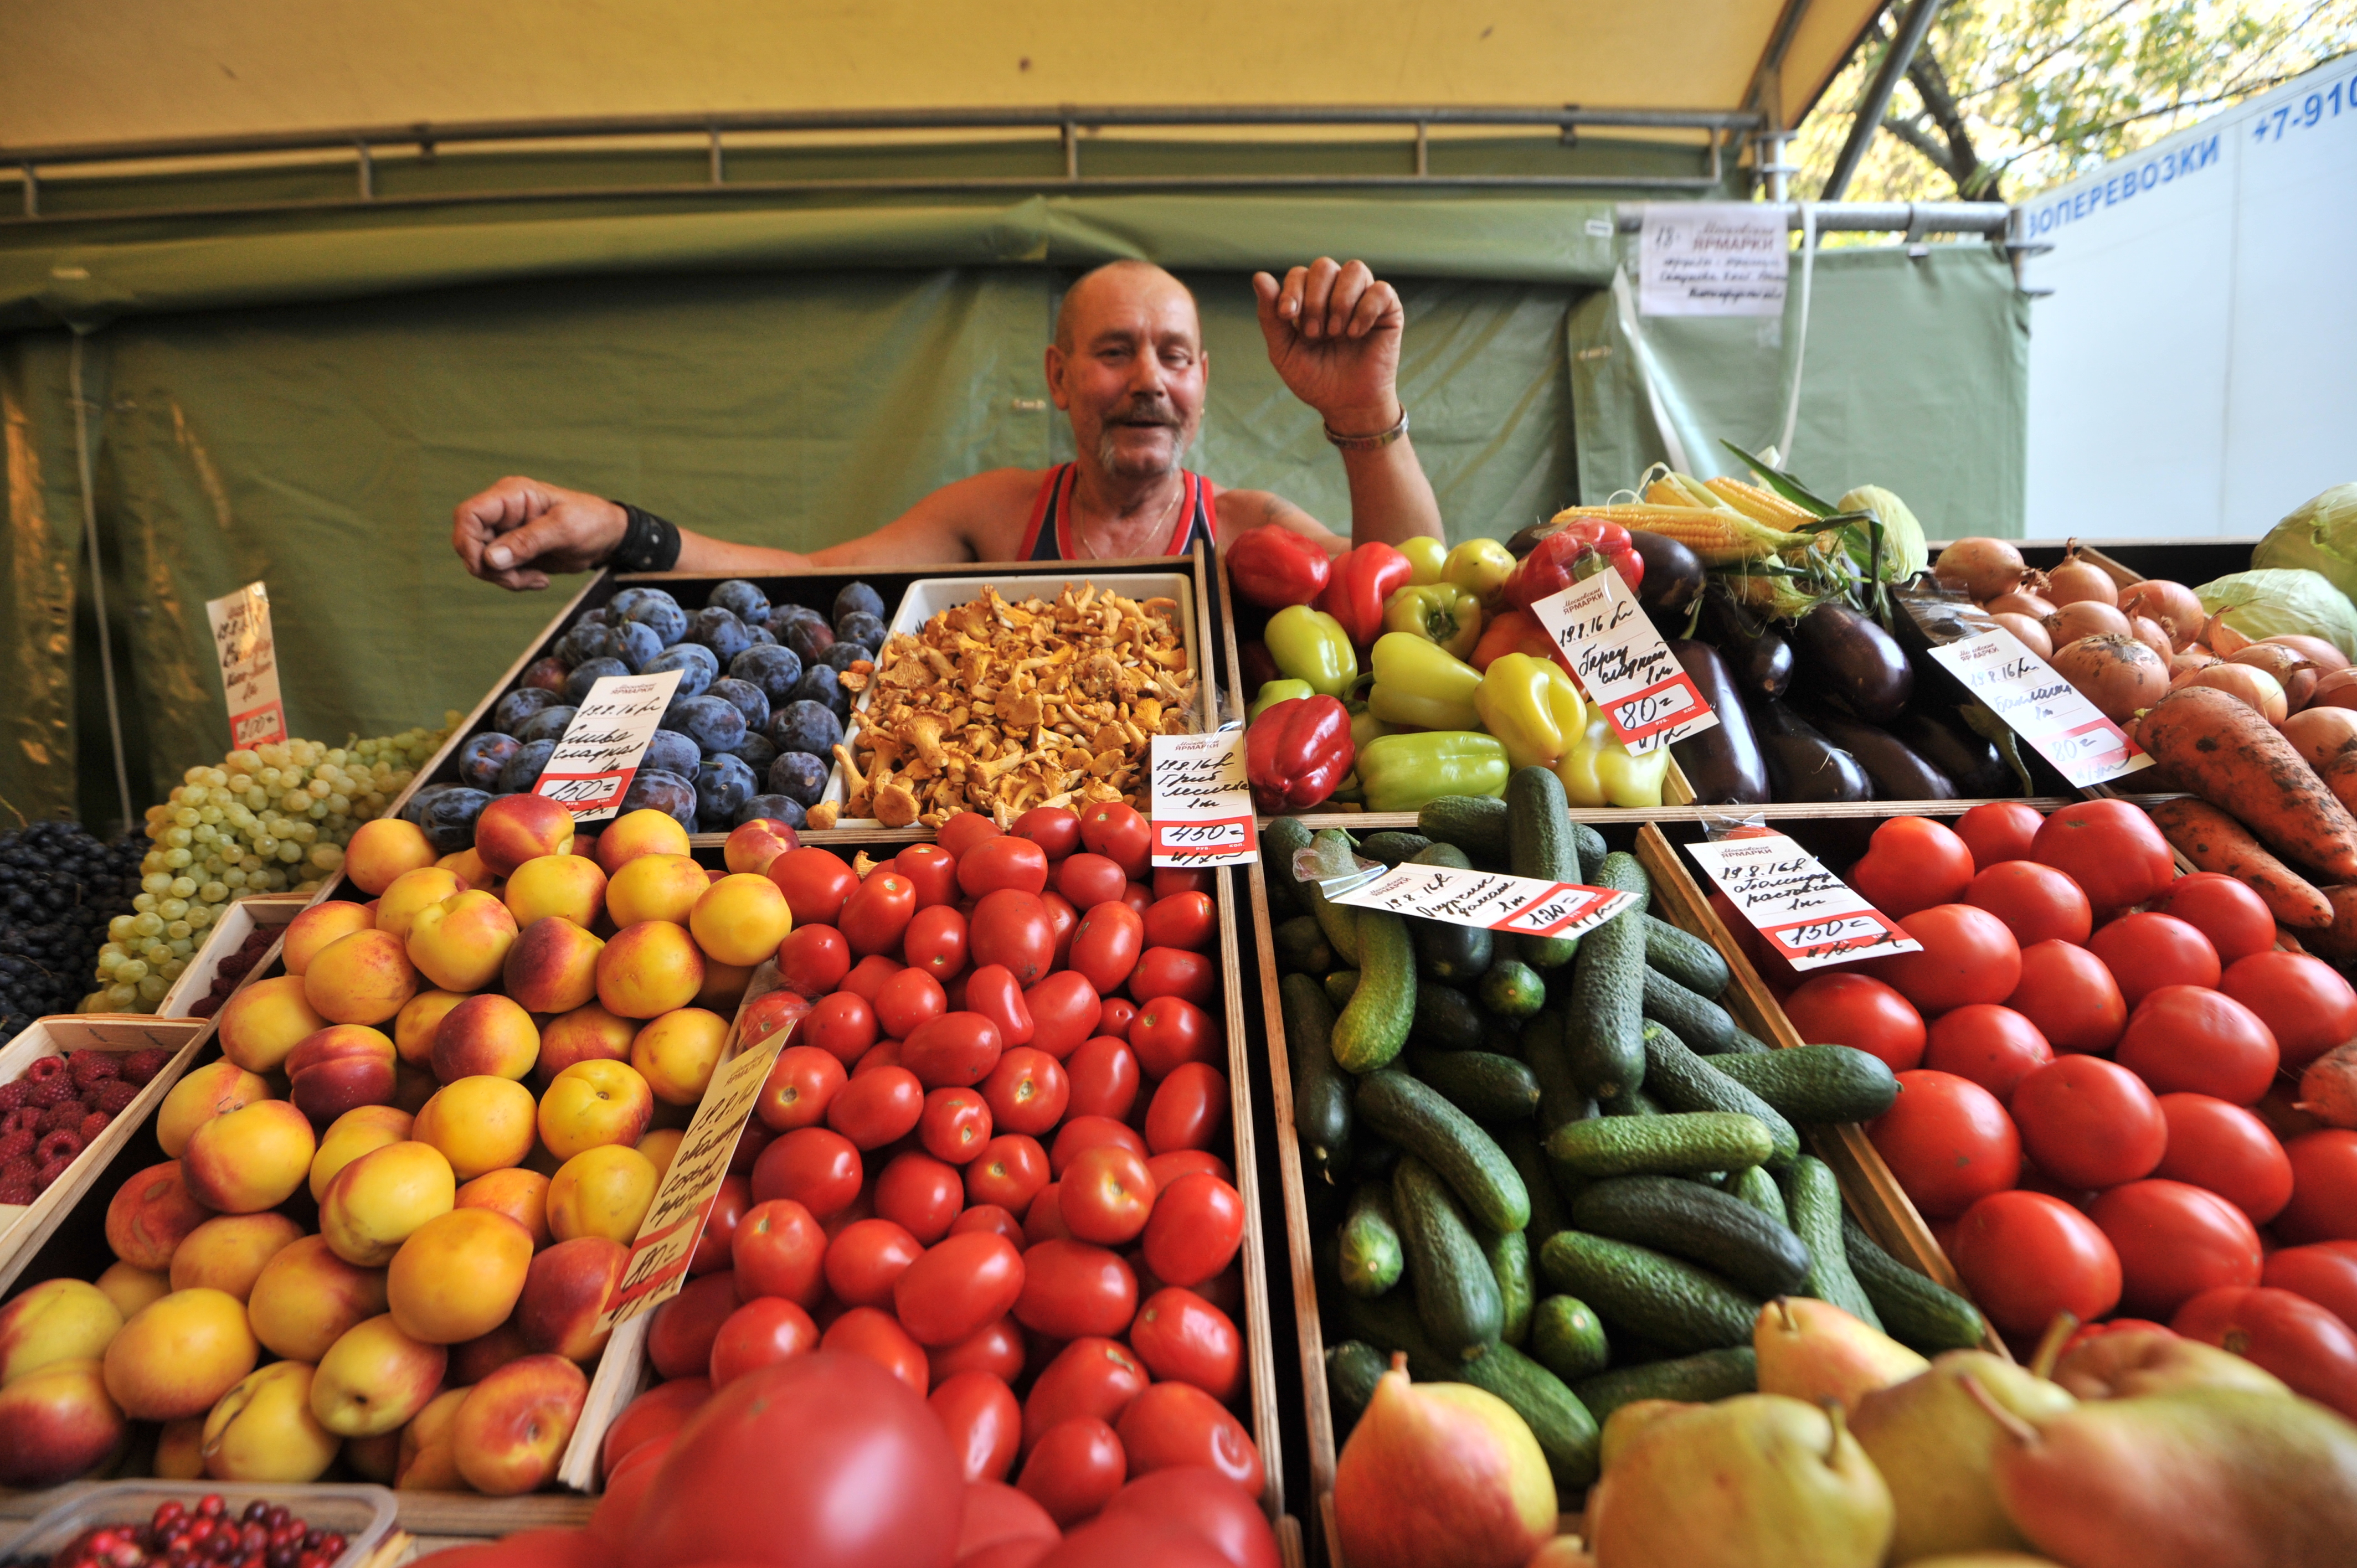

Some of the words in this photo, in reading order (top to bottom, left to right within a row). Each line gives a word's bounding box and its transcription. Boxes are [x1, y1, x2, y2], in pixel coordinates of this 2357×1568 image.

[1694, 239, 1773, 249] ЯРМАРКИ
[1563, 587, 1602, 608] Московские
[1563, 592, 1604, 615] ЯРМАРКИ
[562, 725, 634, 744] Слива
[553, 741, 645, 764] сладкая
[1157, 770, 1222, 787] Гриб
[1721, 849, 1773, 858] ЯРМАРКИ
